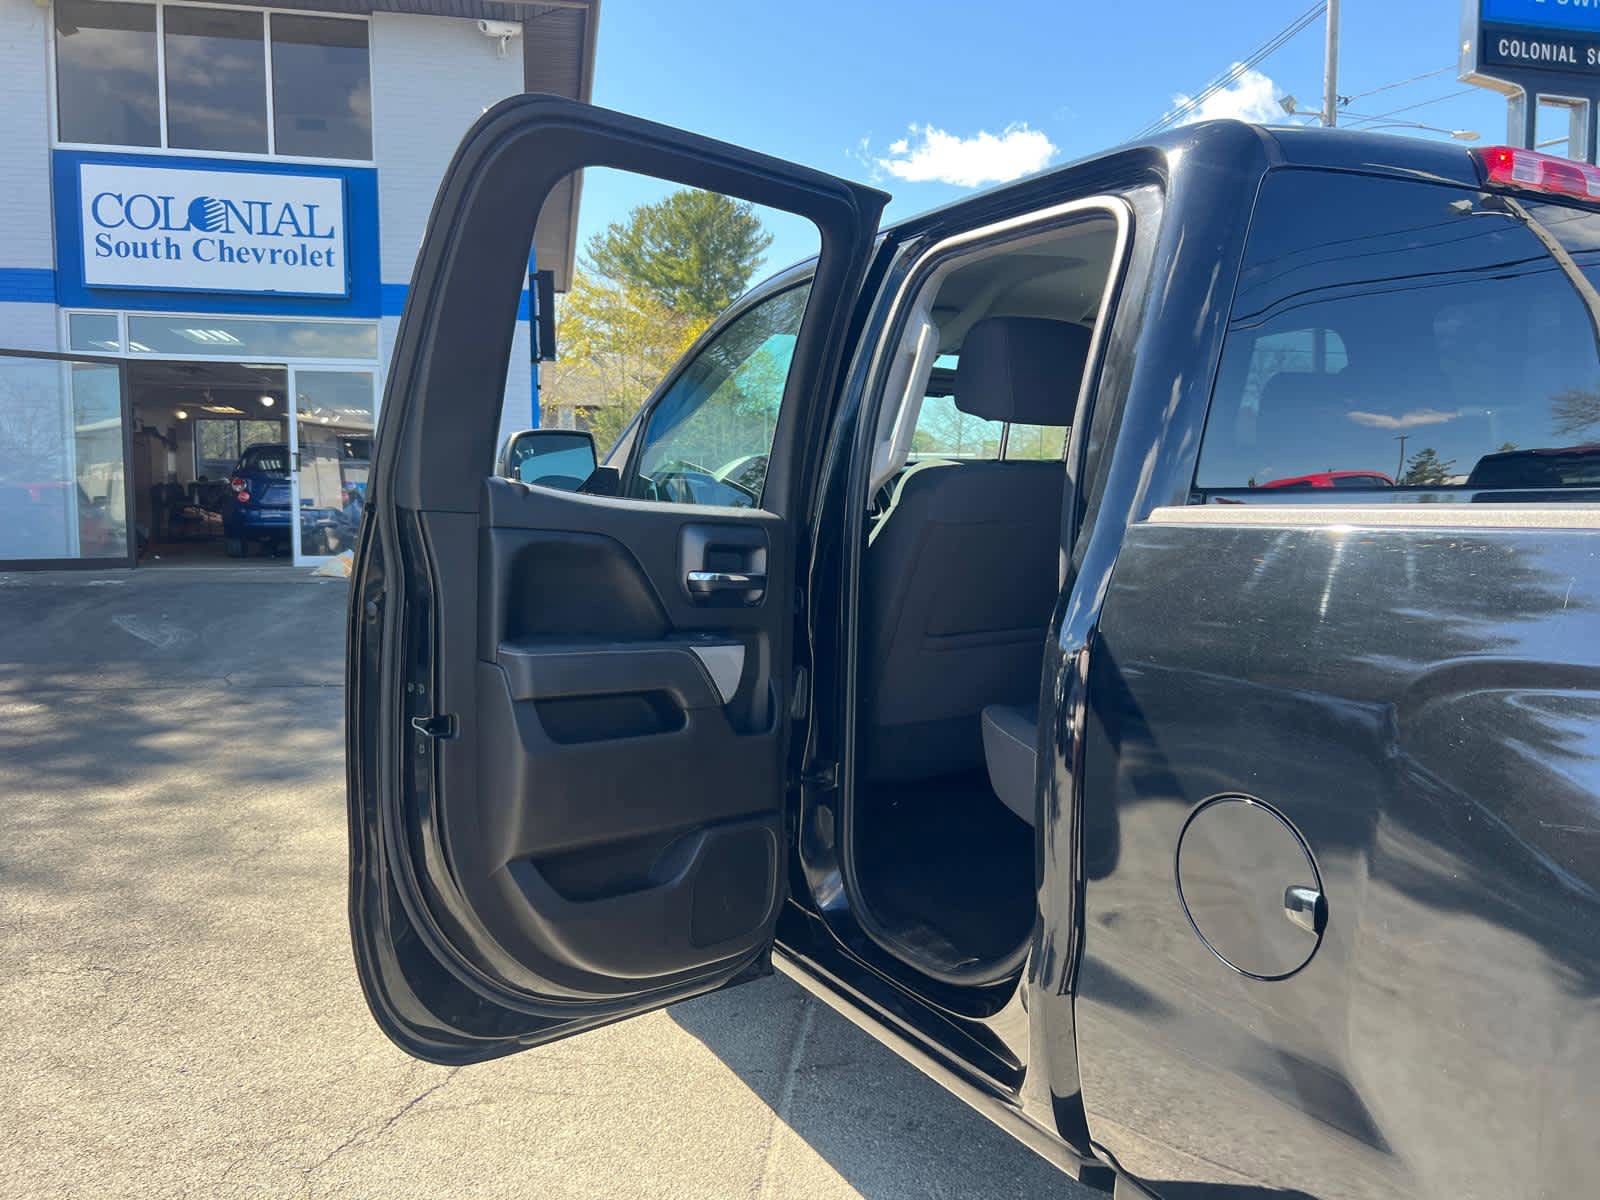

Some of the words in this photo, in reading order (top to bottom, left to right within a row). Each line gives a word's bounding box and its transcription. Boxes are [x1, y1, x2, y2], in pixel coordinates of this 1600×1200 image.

[1498, 39, 1577, 63] COLONIAL
[91, 191, 335, 239] COLONIAL
[95, 232, 182, 260] South
[192, 238, 336, 268] Chevrolet
